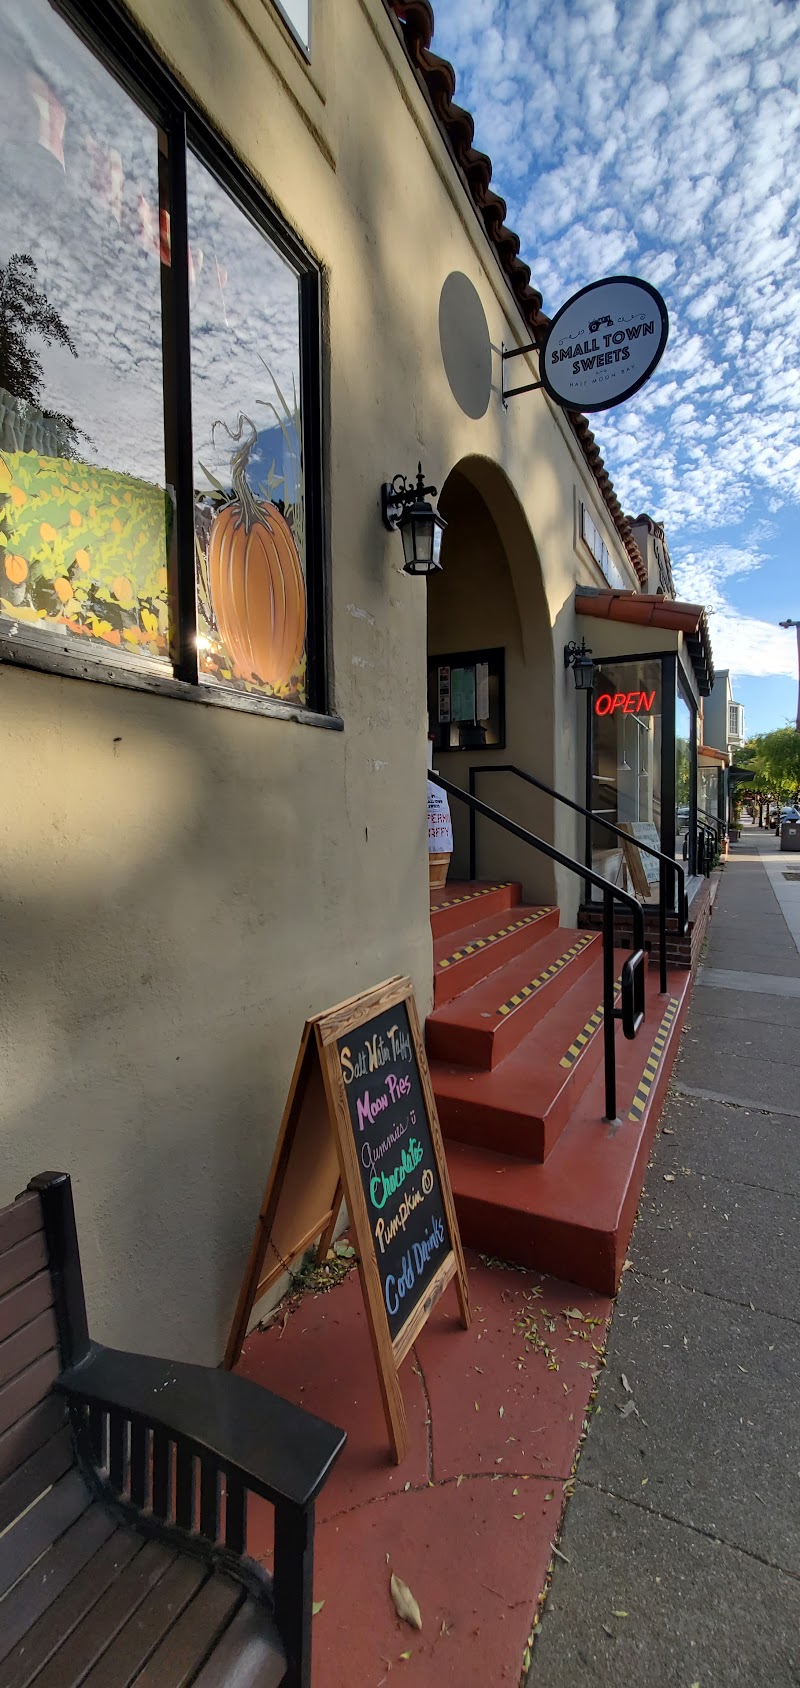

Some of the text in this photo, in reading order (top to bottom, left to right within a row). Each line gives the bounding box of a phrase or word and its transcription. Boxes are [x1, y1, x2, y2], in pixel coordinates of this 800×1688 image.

[552, 321, 654, 364] SMALL TOWN
[572, 346, 630, 374] SWEETS
[592, 373, 616, 383] MOON
[621, 364, 635, 375] BAY
[595, 690, 656, 716] OPEN
[340, 1024, 412, 1084] Salt Water Taffy
[356, 1073, 411, 1131] Moon Pies
[369, 1137, 424, 1209] Chocolates
[375, 1186, 424, 1253] Pumpkin
[385, 1215, 444, 1315] Cold Drinks
